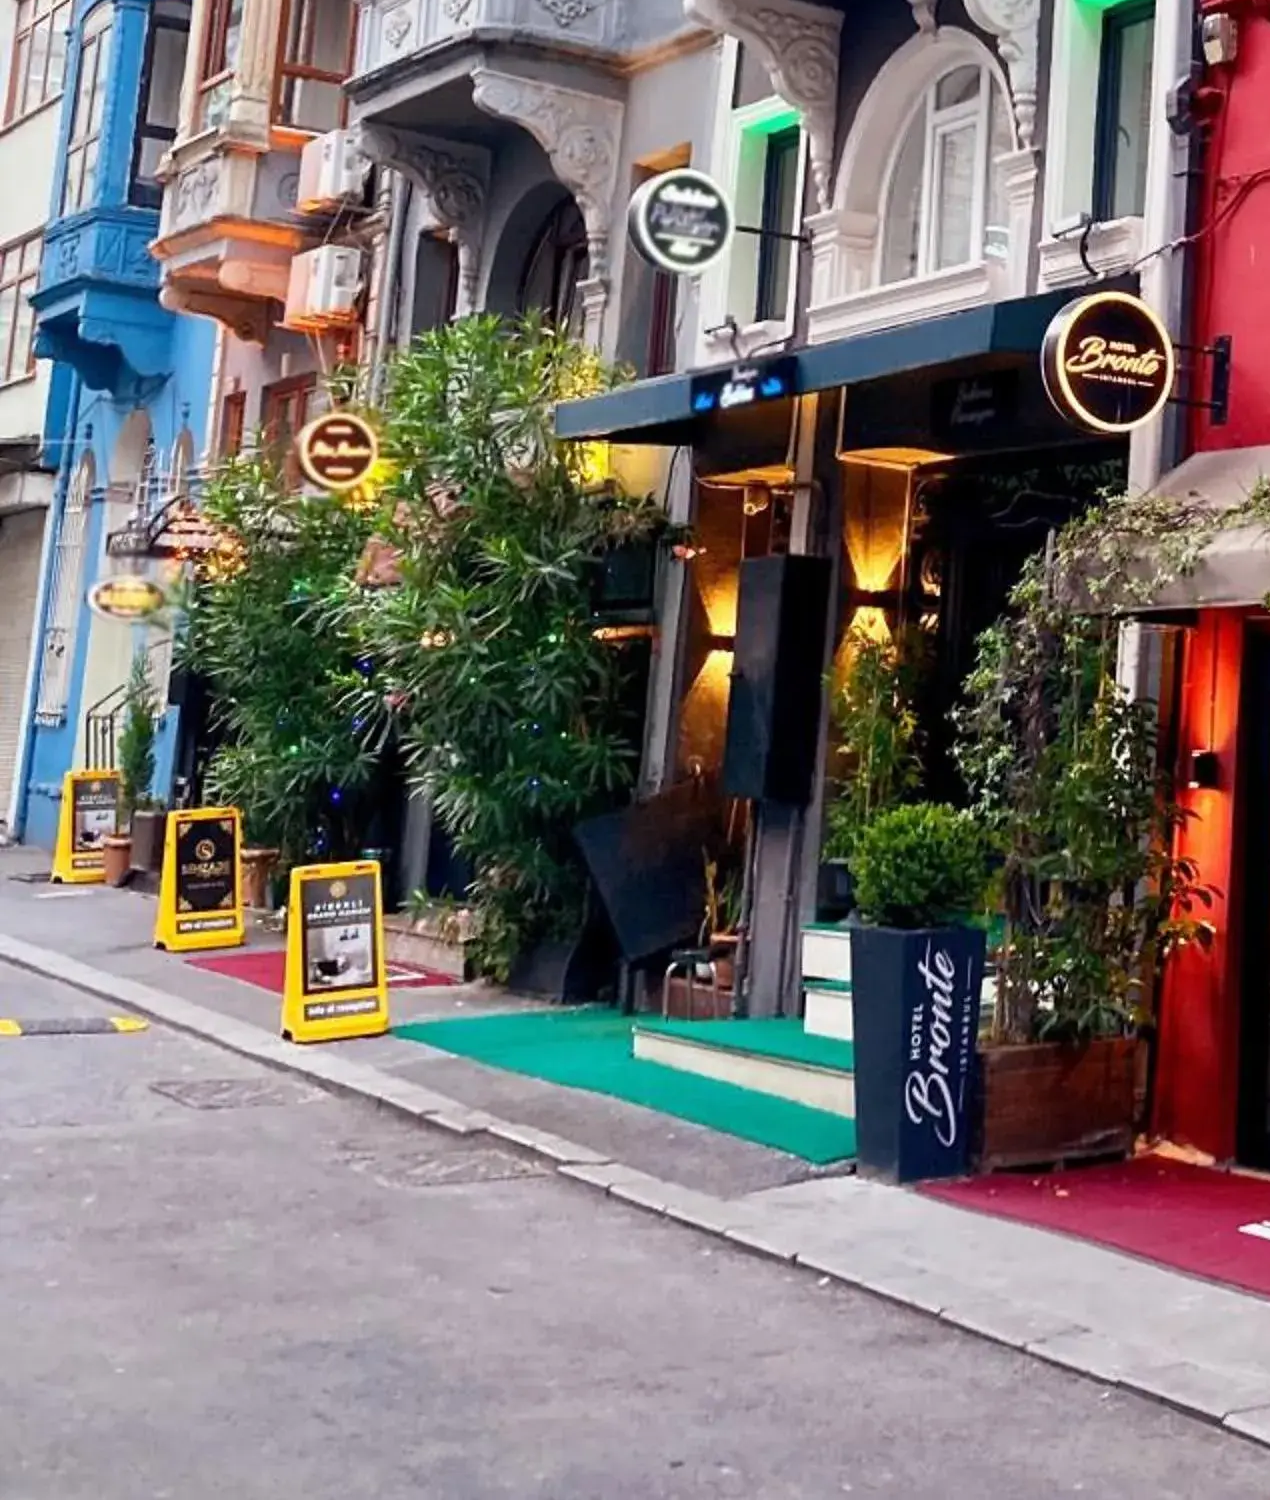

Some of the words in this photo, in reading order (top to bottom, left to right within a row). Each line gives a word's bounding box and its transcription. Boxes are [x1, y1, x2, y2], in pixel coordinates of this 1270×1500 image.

[1065, 336, 1166, 376] Bronte
[905, 937, 956, 1148] Bronte
[910, 1003, 924, 1061] HOTEL
